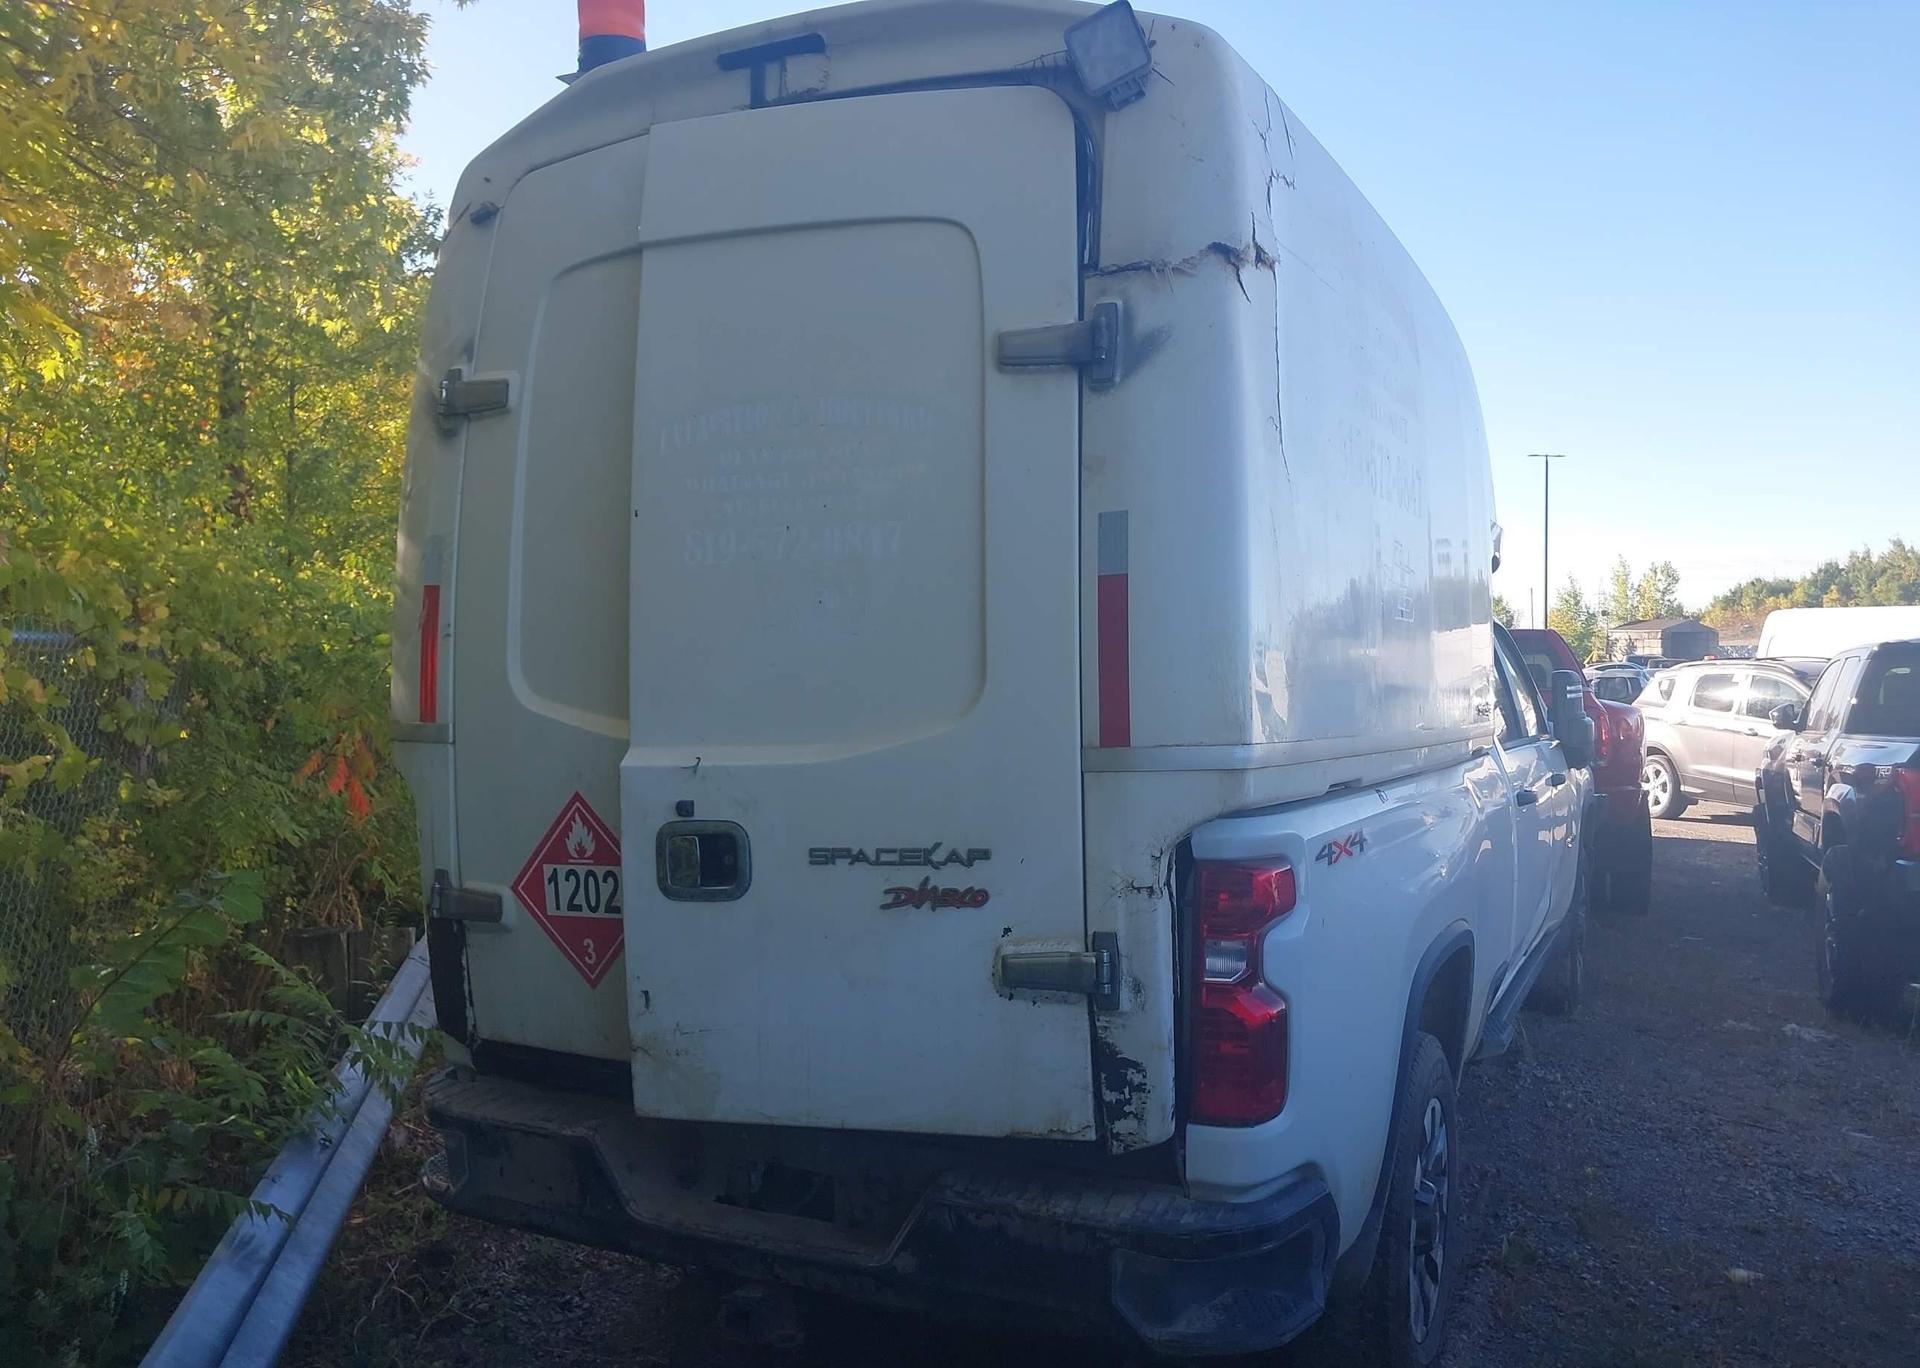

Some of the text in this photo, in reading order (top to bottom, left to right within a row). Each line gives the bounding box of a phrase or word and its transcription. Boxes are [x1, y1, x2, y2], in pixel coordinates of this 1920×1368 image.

[1875, 766, 1892, 777] TRD
[808, 842, 992, 870] SPACEKAP
[547, 868, 621, 914] 1202
[583, 938, 596, 965] 3
